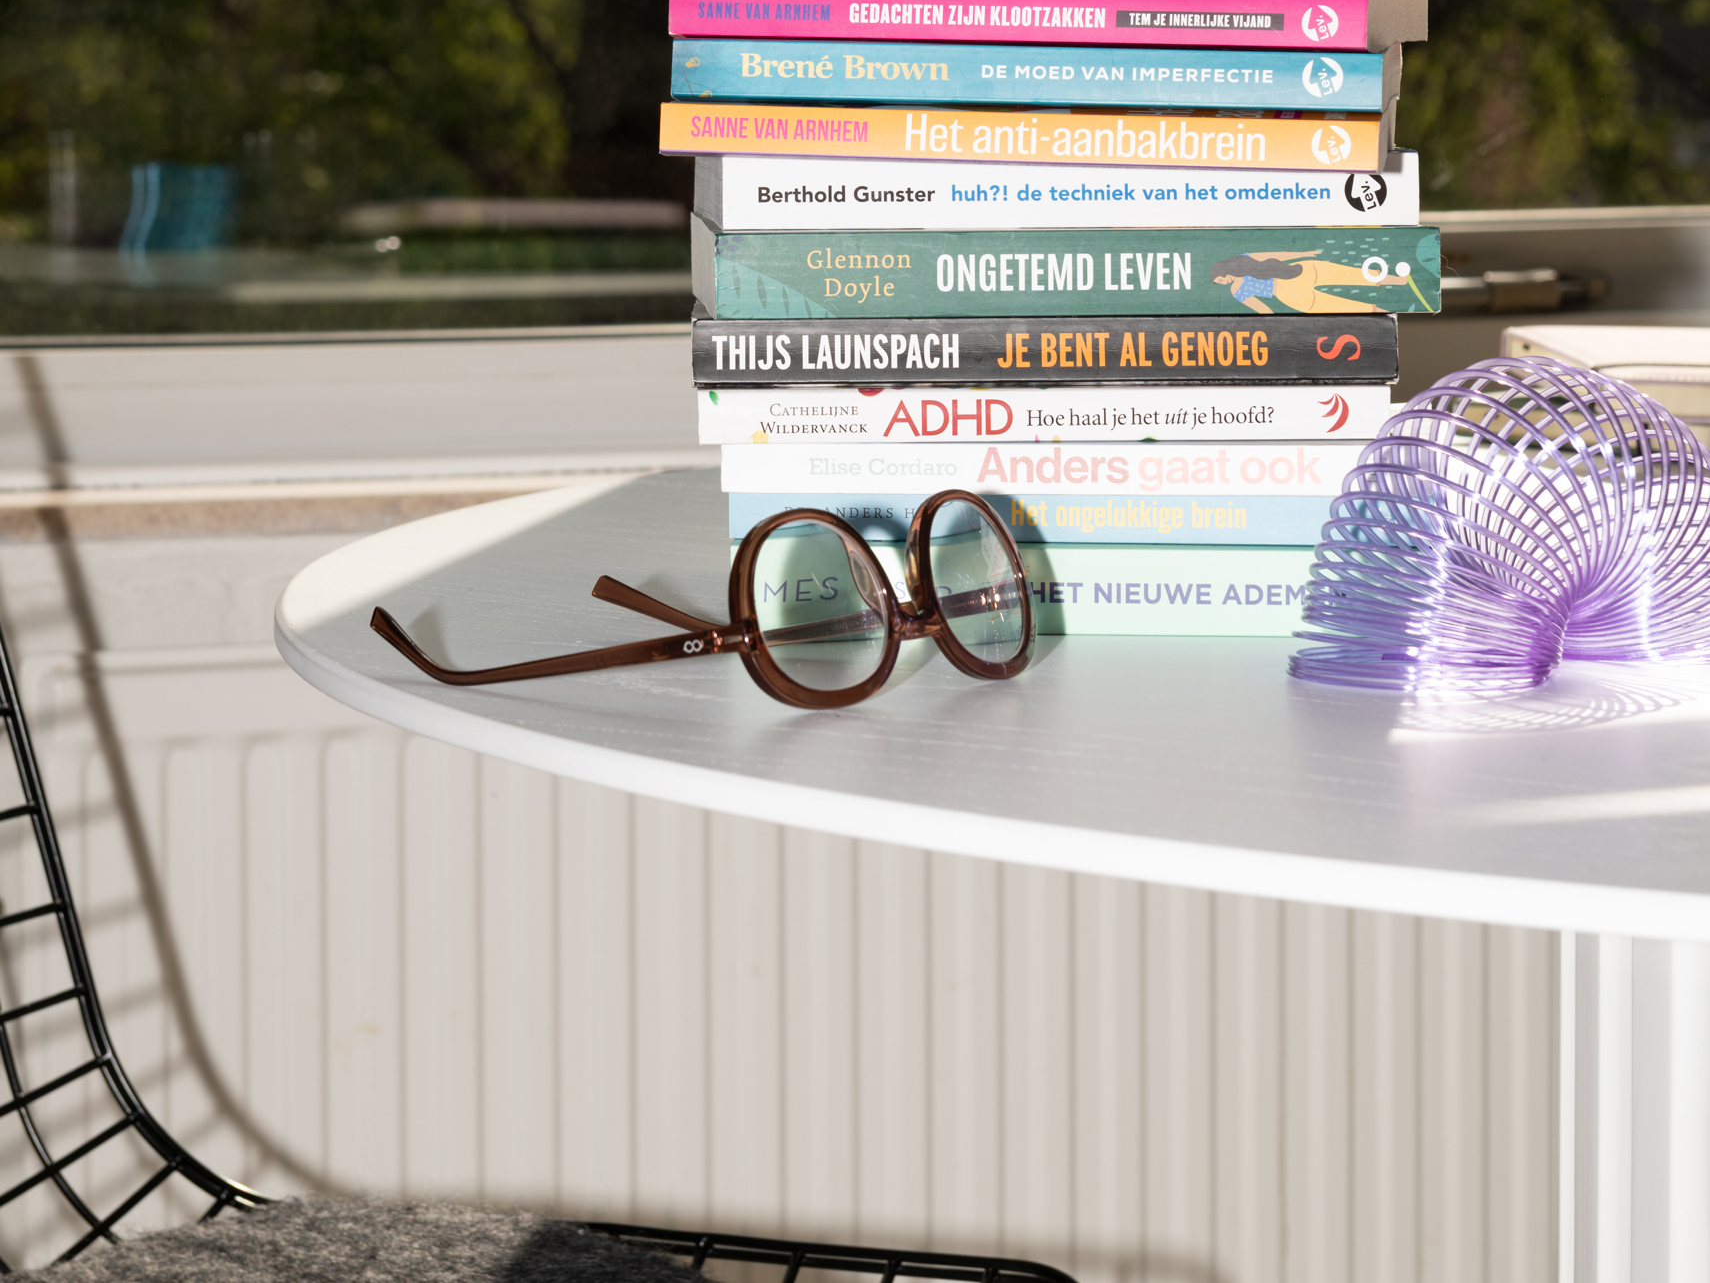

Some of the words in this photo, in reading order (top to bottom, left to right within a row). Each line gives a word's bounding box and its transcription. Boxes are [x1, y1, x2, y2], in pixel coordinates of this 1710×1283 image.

[698, 1, 740, 20] SANNE
[745, 2, 770, 21] VAN
[775, 3, 831, 22] ARNHEM
[849, 2, 943, 25] GEDACHTEN
[948, 4, 986, 27] ZIJN
[990, 5, 1106, 29] KLOOTZAKKEN
[1129, 12, 1152, 26] TEM
[1153, 13, 1167, 27] JE
[1169, 13, 1231, 28] INNERLIJKE
[1233, 15, 1272, 29] VIJAND
[740, 52, 834, 79] Brené
[843, 54, 950, 81] Brown
[981, 64, 1007, 79] DE
[1014, 65, 1075, 80] MOED
[1081, 66, 1125, 81] VAN
[1132, 67, 1274, 84] IMPERFECTIE
[690, 115, 749, 139] SANNE
[754, 118, 789, 140] VAN
[793, 119, 868, 143] ARNHEM
[905, 113, 963, 153] Het
[972, 117, 1266, 162] anti-aanbakbrein
[757, 185, 846, 203] Berthold
[853, 185, 936, 203] Gunster
[951, 184, 1008, 202] huh?!
[1017, 184, 1042, 201] de
[1049, 183, 1136, 201] techniek
[1142, 187, 1178, 201] van
[1185, 183, 1218, 201] het
[1226, 182, 1331, 200] omdenken
[806, 248, 912, 270] Glennon
[936, 252, 1094, 293] ONGETEMD
[1104, 252, 1192, 291] LEVEN
[824, 275, 895, 304] Doyle
[712, 334, 792, 371] THIJS
[801, 333, 960, 370] LAUNSPACH
[997, 332, 1031, 369] JE
[1041, 331, 1110, 369] BENT
[1119, 332, 1152, 368] AL
[1161, 330, 1269, 368] GENOEG
[883, 398, 1014, 438] ADHD
[1026, 408, 1065, 428] Hoe
[1069, 407, 1109, 426] haal
[1111, 409, 1127, 430] je
[1131, 406, 1161, 425] het
[1191, 407, 1207, 430] je
[1211, 405, 1275, 425] hoofd?
[809, 458, 862, 476] Elise
[868, 457, 958, 476] Cordaro
[976, 446, 1130, 485] Anders
[1138, 449, 1231, 492] gaat
[1240, 447, 1322, 484] ook
[1011, 498, 1049, 527] Het
[1055, 499, 1184, 533] ongelukkige
[1191, 501, 1247, 529] brein
[763, 576, 839, 603] MES
[1031, 581, 1084, 603] HET
[1093, 582, 1212, 605] NIEUWE
[1221, 583, 1346, 606] ADEM
